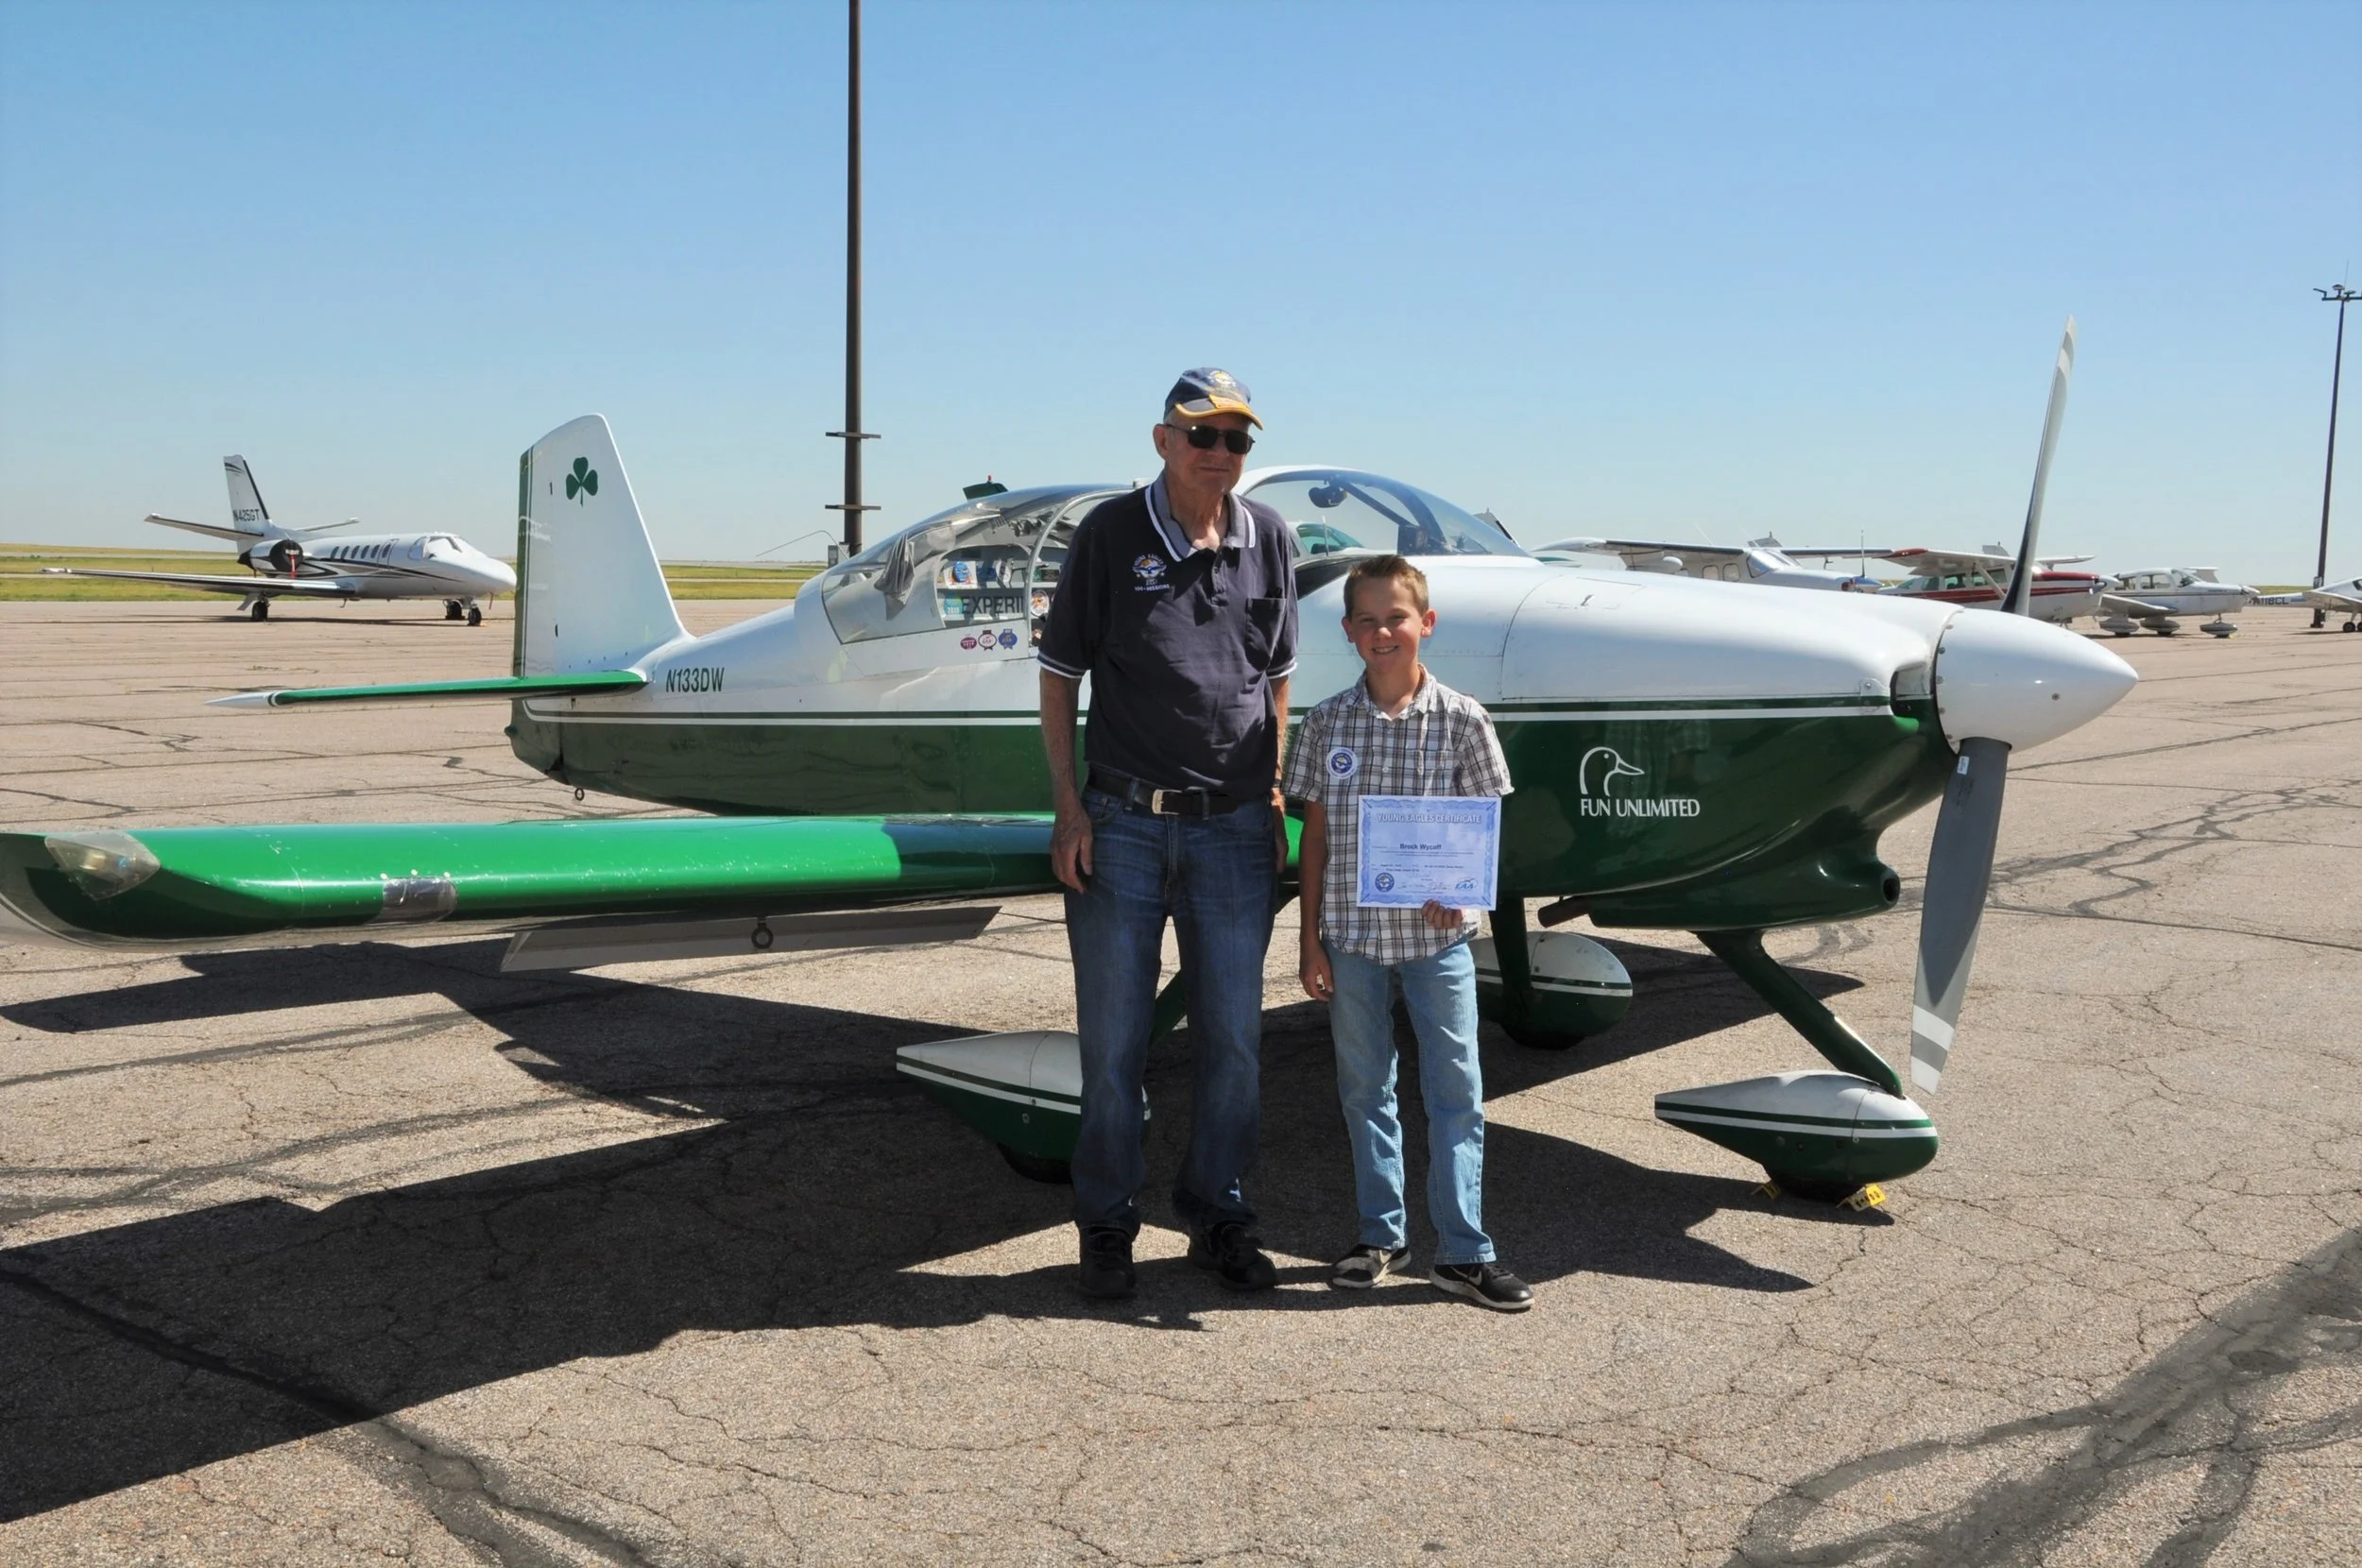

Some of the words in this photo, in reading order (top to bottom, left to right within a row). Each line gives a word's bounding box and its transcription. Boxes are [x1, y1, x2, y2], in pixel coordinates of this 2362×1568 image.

[232, 509, 260, 521] N425GT
[665, 667, 726, 693] N133DW
[1581, 798, 1611, 817] FUN
[1616, 798, 1701, 817] UNLIMITED
[1378, 813, 1405, 823] YOUNG
[1406, 813, 1435, 824] EAGLES
[1436, 814, 1481, 825] CERTIFICATE
